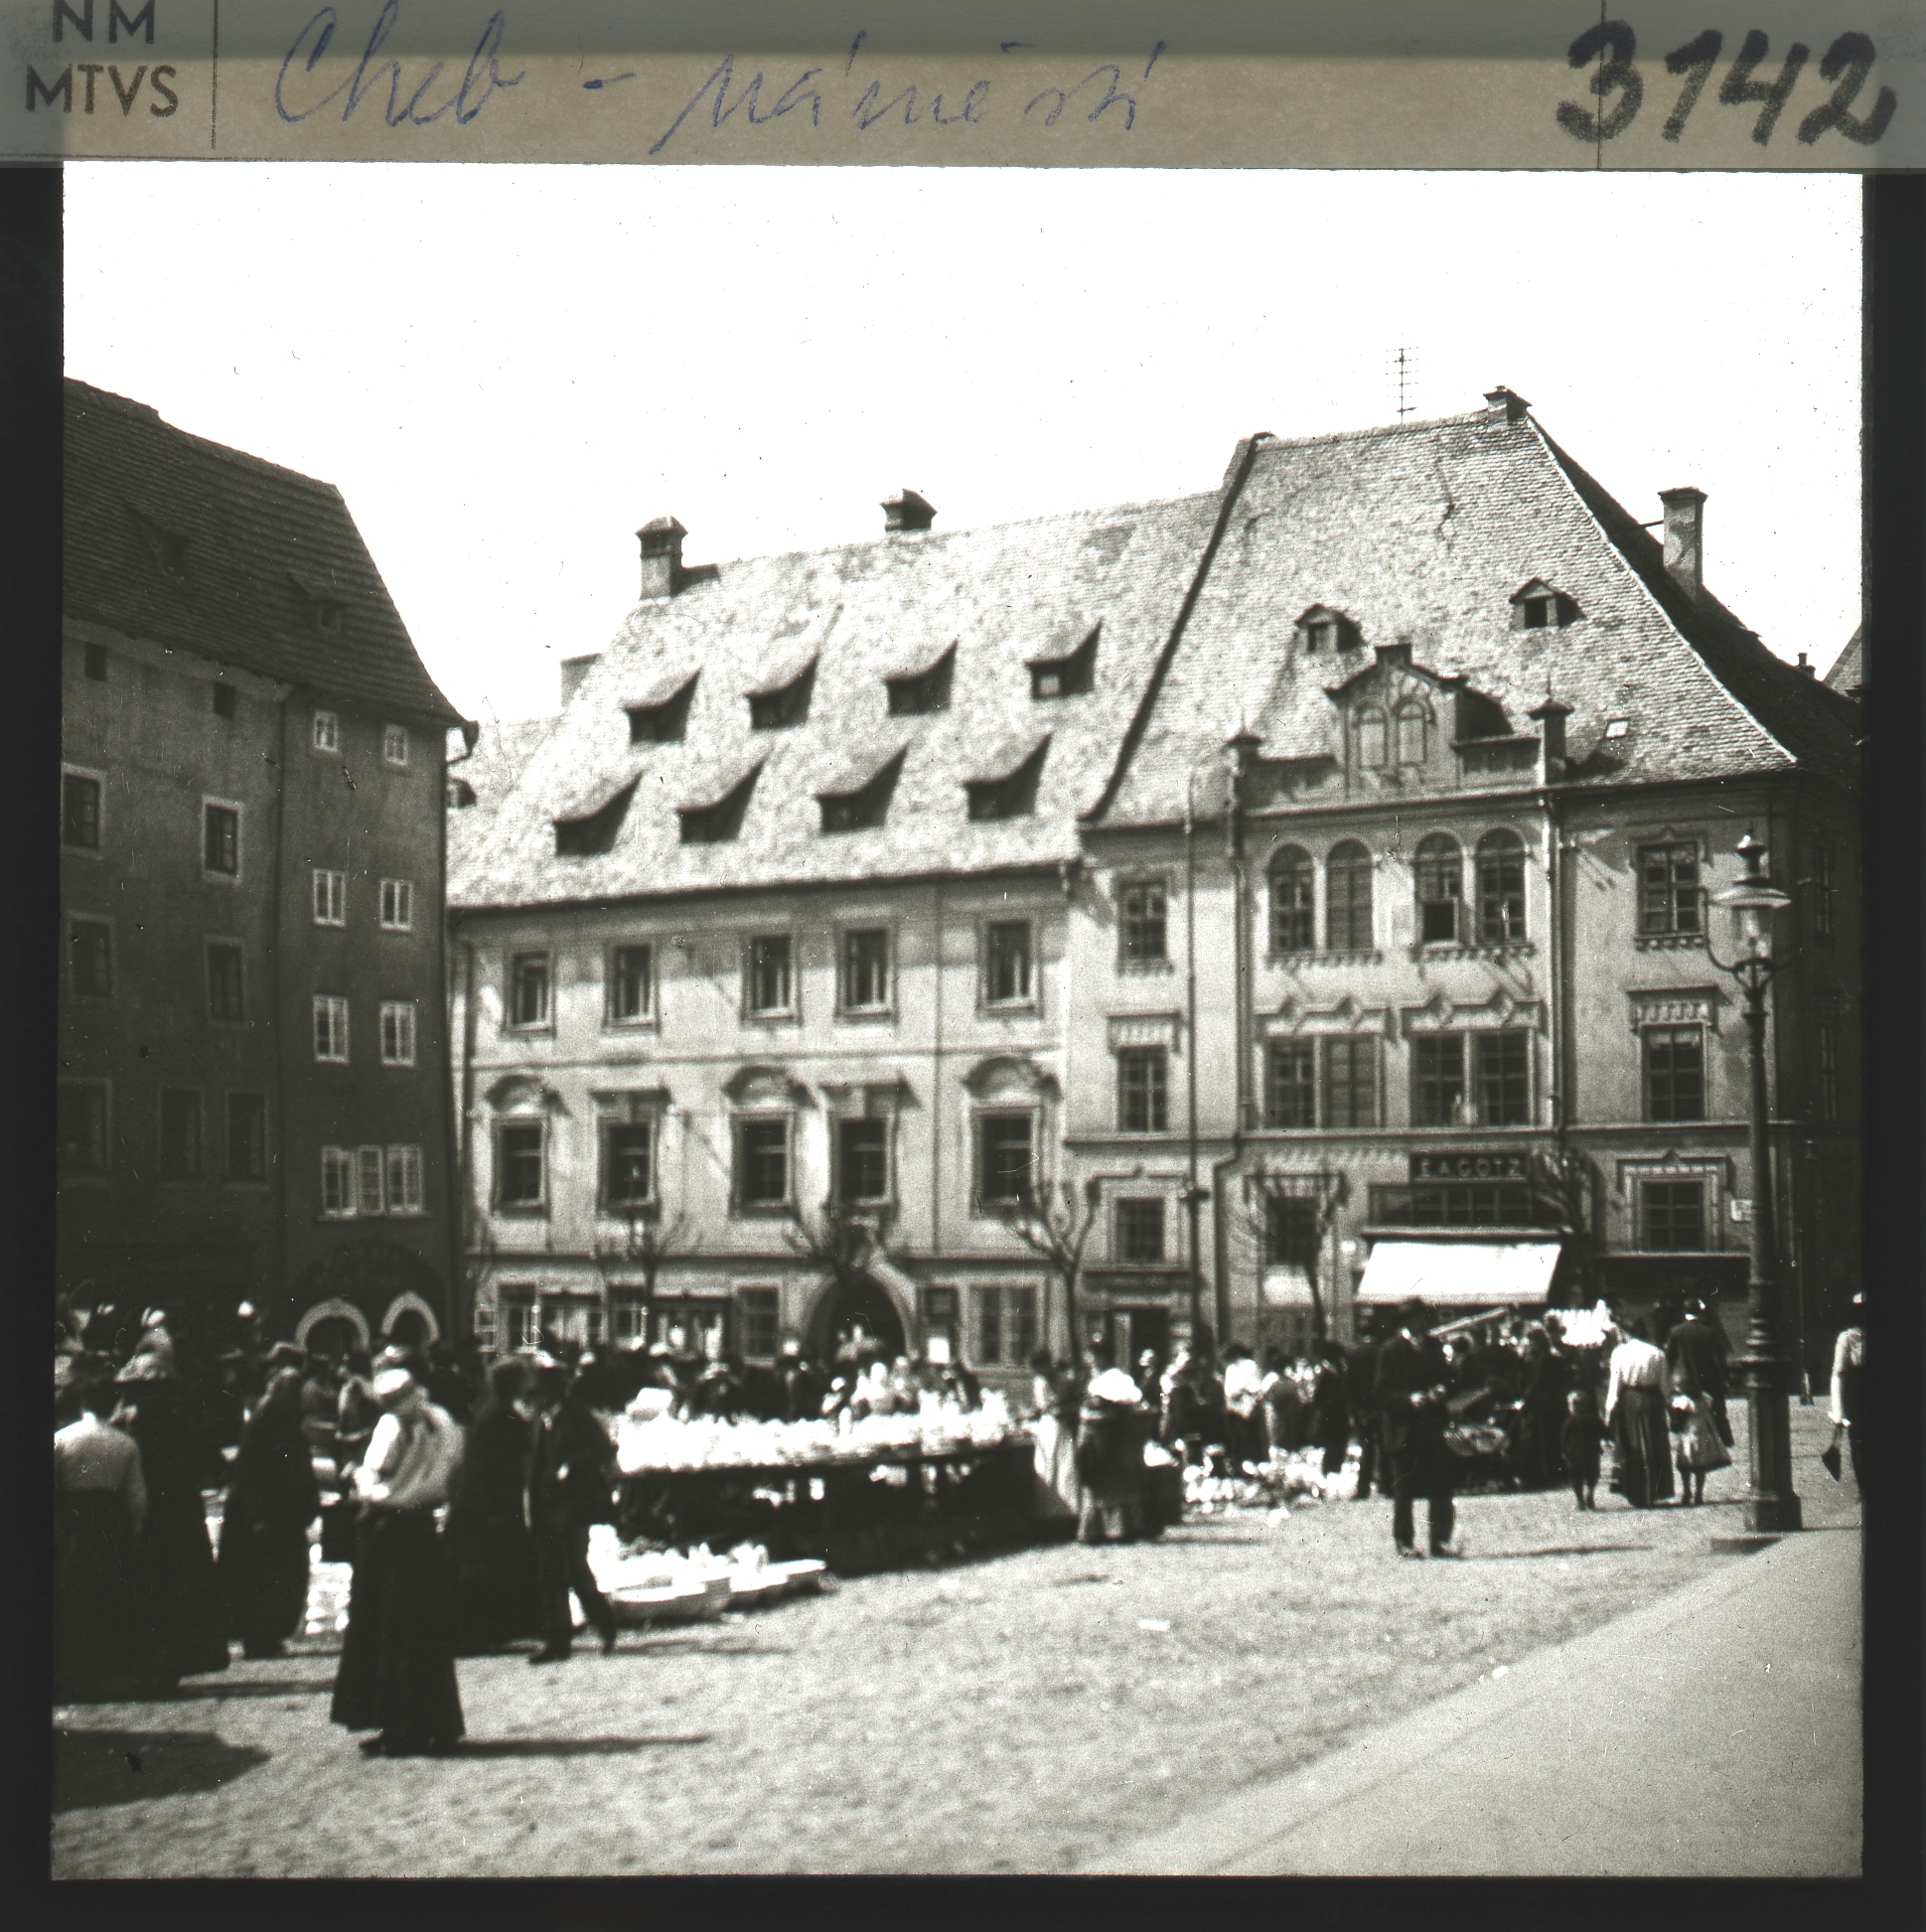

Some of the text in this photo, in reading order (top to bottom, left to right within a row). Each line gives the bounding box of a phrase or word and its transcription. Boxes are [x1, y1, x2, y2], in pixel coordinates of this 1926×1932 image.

[52, 0, 156, 45] NM
[275, 0, 526, 127] Cheb
[26, 65, 179, 117] MTVS
[1556, 19, 1897, 146] 3142
